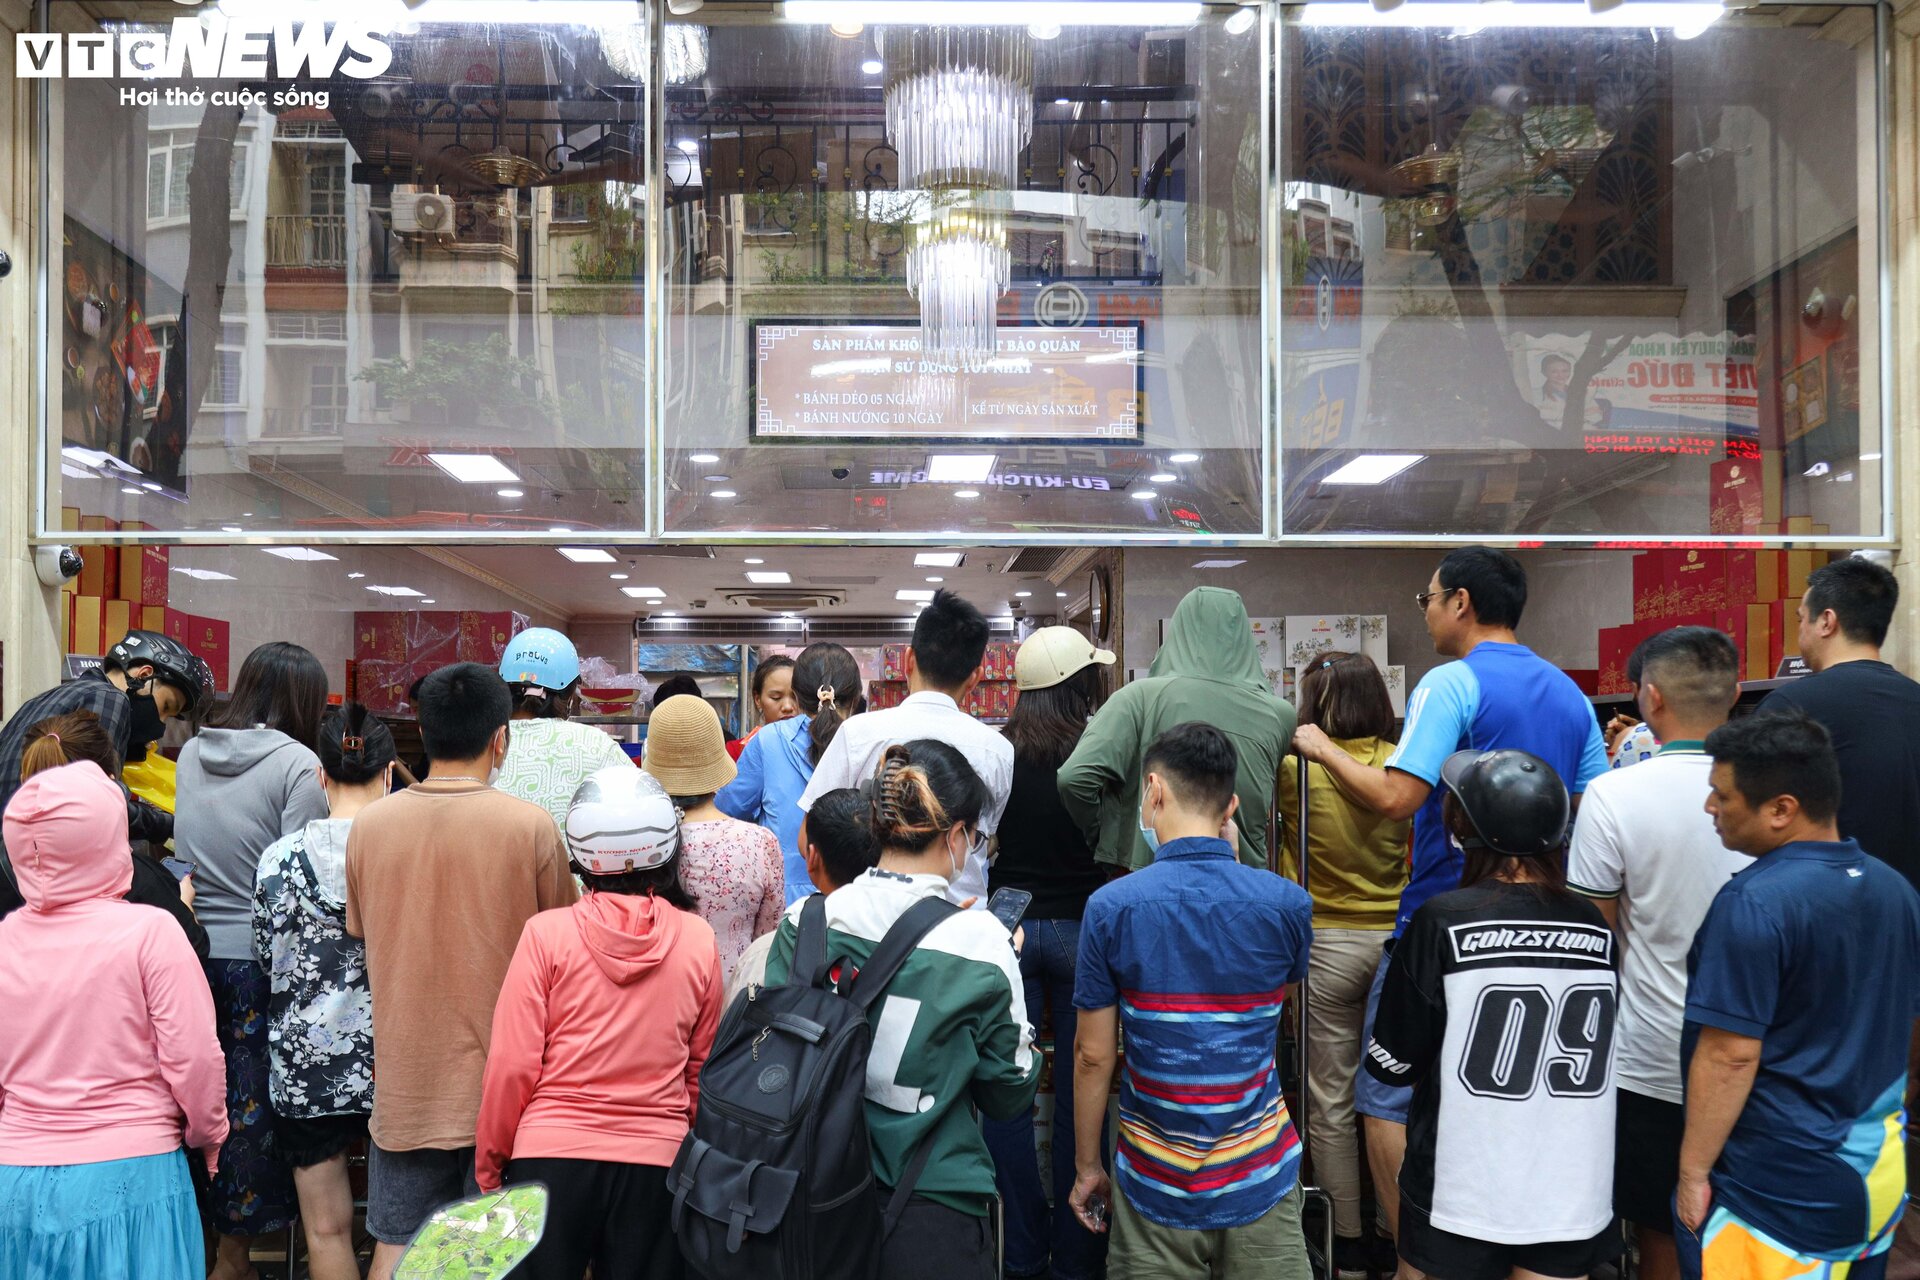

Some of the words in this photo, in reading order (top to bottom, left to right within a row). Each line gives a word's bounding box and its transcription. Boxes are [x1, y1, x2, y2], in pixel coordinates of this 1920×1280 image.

[812, 335, 841, 351] SẢN
[845, 334, 885, 351] PHẨM
[889, 336, 922, 351] KHÔ
[1006, 336, 1036, 351] BẢO
[1039, 336, 1081, 352] QUẢN
[895, 357, 915, 373] SỬ
[803, 393, 840, 405] BÁNH
[842, 392, 868, 405] DẺO
[871, 394, 883, 405] 05
[988, 401, 1006, 415] TỪ
[1007, 402, 1039, 415] NGÀY
[1041, 402, 1066, 415] SẢN
[1068, 401, 1098, 415] XUẤT
[803, 411, 840, 424] BÁNH
[842, 410, 889, 424] NƯỚNG
[893, 412, 904, 424] 10
[907, 411, 944, 424] NGÀY
[1458, 983, 1617, 1101] 09
